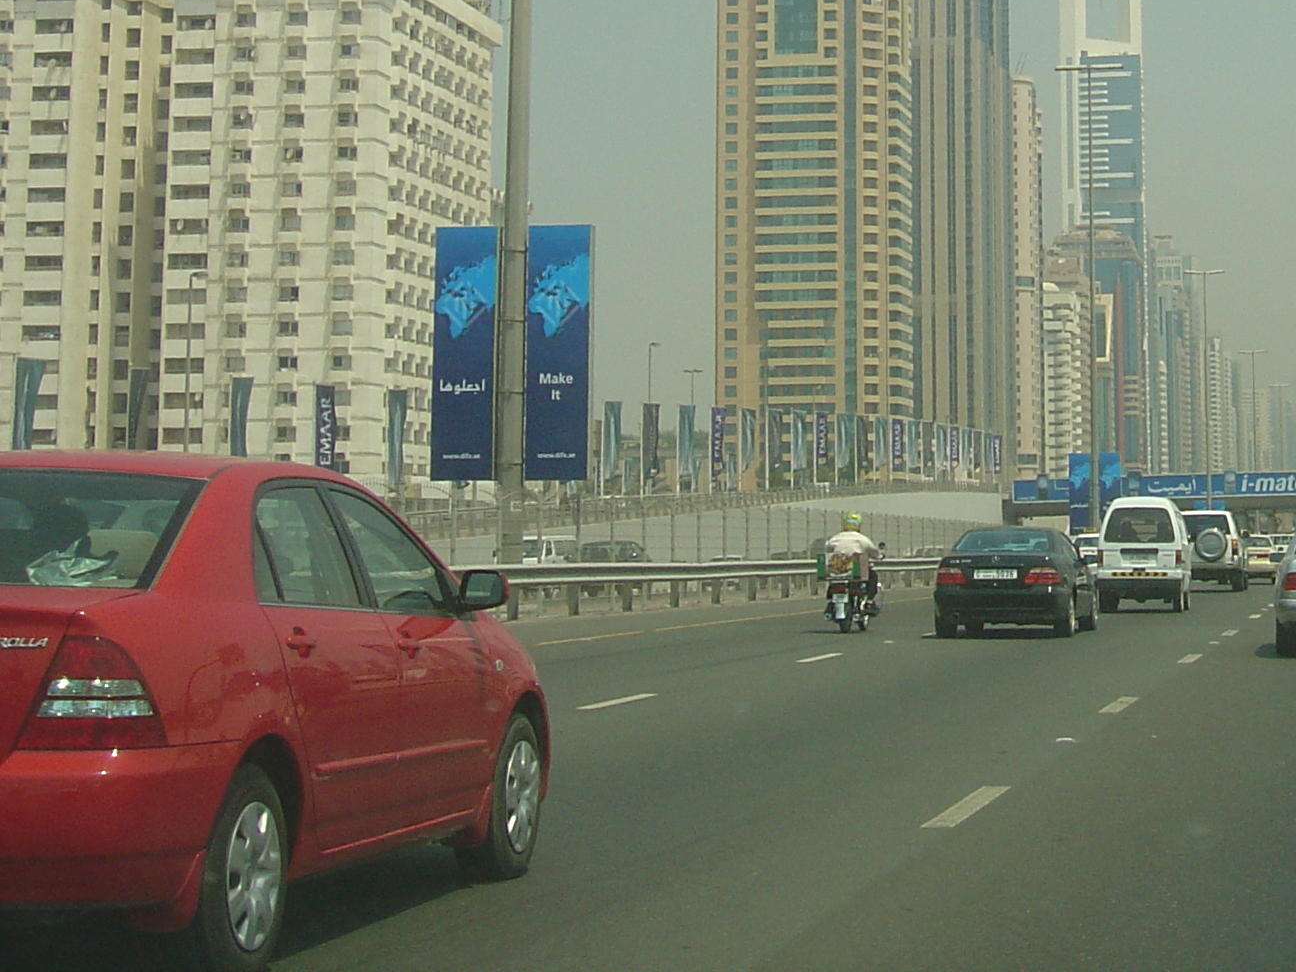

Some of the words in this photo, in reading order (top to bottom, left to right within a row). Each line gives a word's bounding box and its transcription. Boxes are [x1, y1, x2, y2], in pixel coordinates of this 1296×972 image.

[539, 372, 574, 385] Make
[551, 390, 561, 401] It
[320, 396, 332, 465] EMAAR
